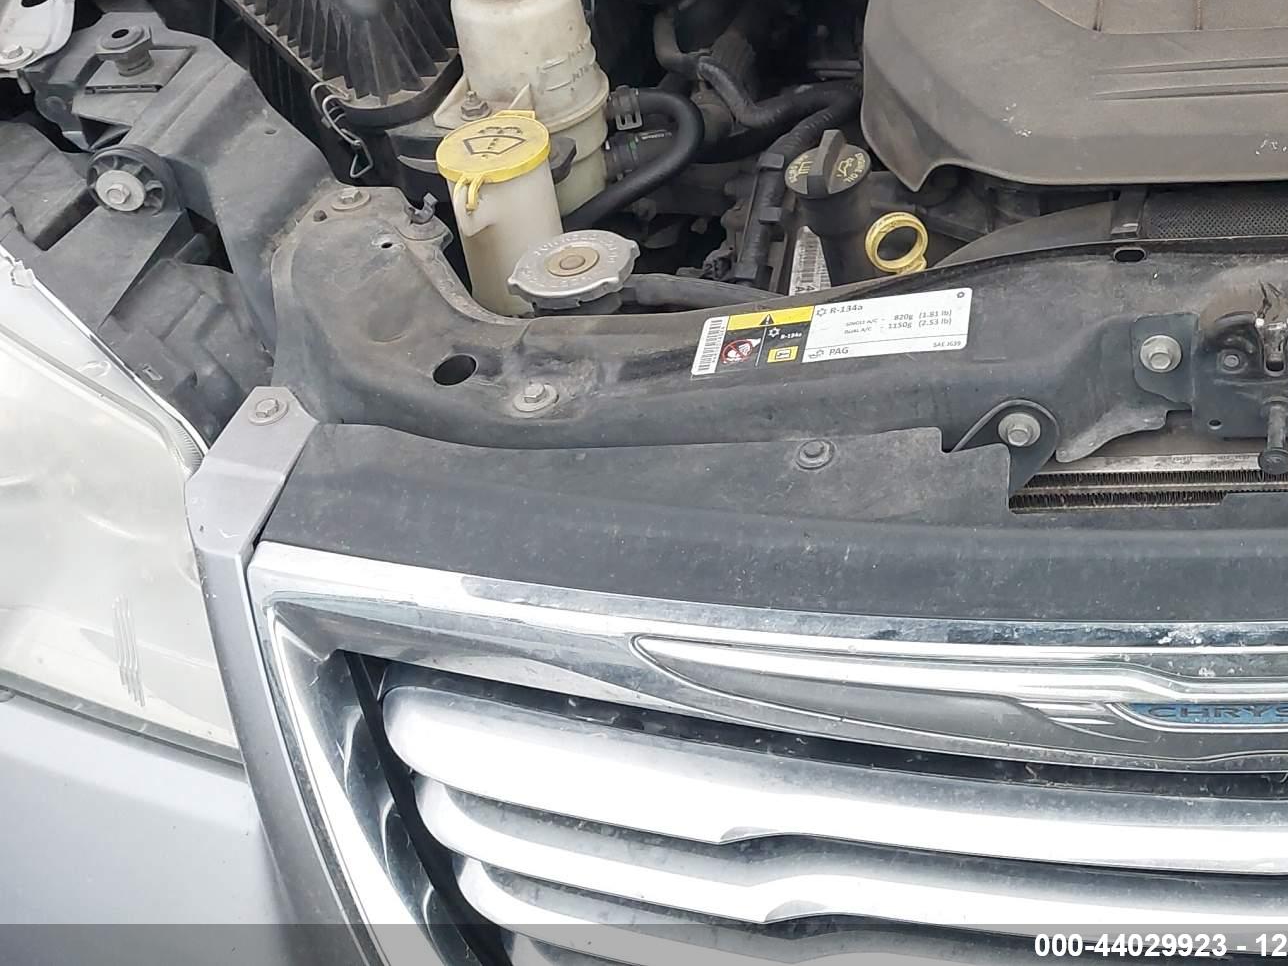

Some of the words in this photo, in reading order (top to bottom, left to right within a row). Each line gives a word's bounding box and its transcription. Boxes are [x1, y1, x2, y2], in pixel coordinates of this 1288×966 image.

[830, 304, 864, 314] R-134a
[894, 313, 914, 321] 820g
[918, 311, 938, 320] (1.81
[941, 309, 952, 317] lb)
[888, 322, 912, 330] 1150g
[918, 319, 939, 327] (2.53
[941, 318, 952, 326] lb)
[828, 346, 850, 356] PAG
